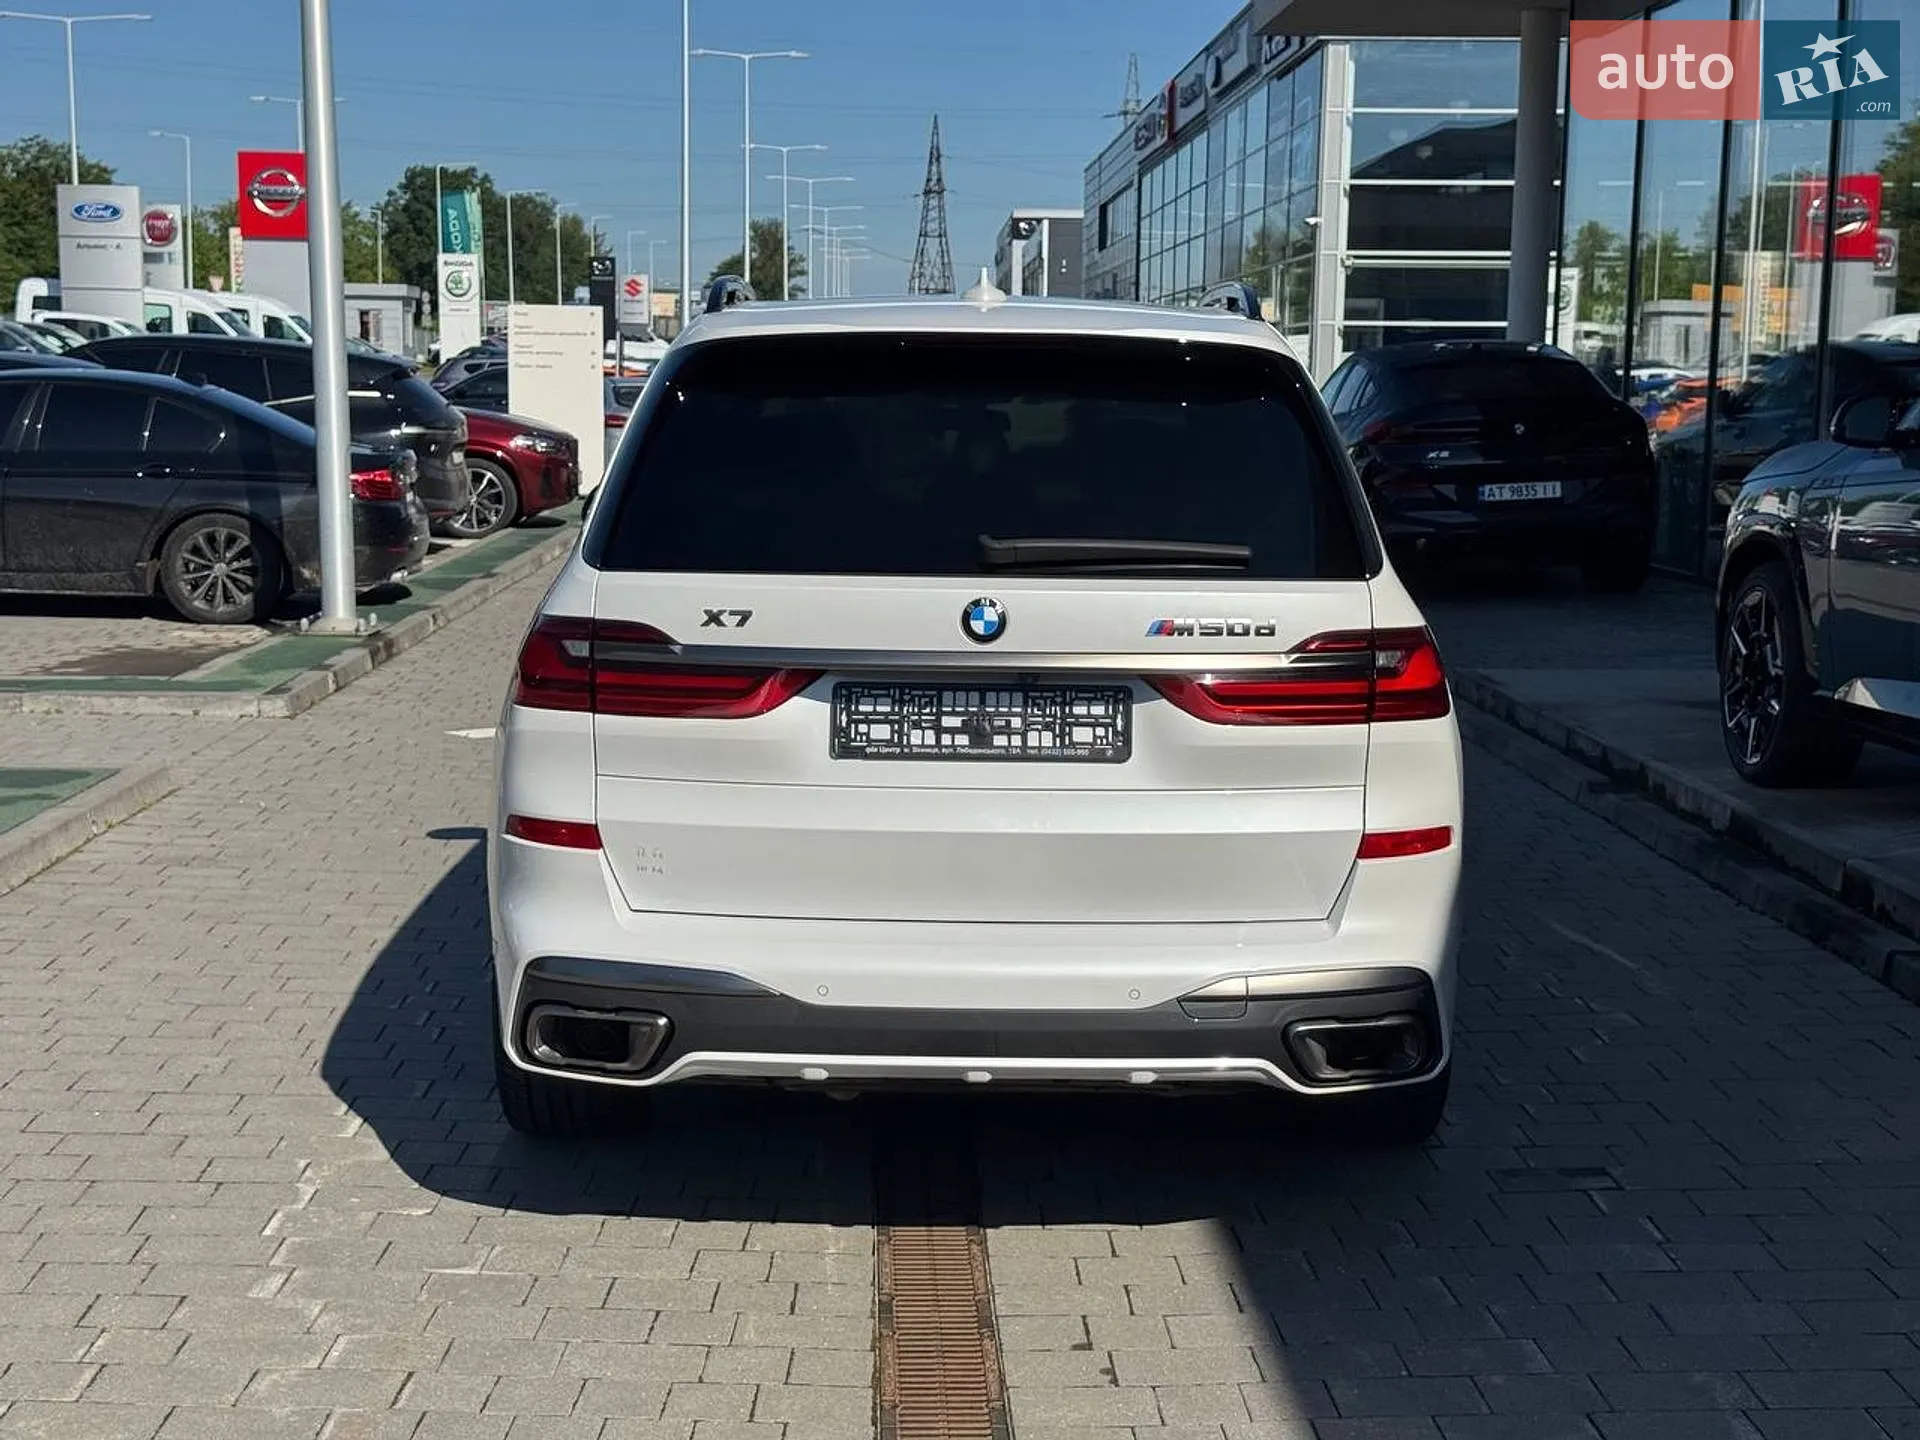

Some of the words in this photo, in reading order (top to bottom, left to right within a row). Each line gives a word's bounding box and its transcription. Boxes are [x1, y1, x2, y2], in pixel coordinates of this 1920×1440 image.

[80, 204, 114, 218] Ford
[1487, 485, 1505, 499] AT
[700, 609, 753, 627] X7
